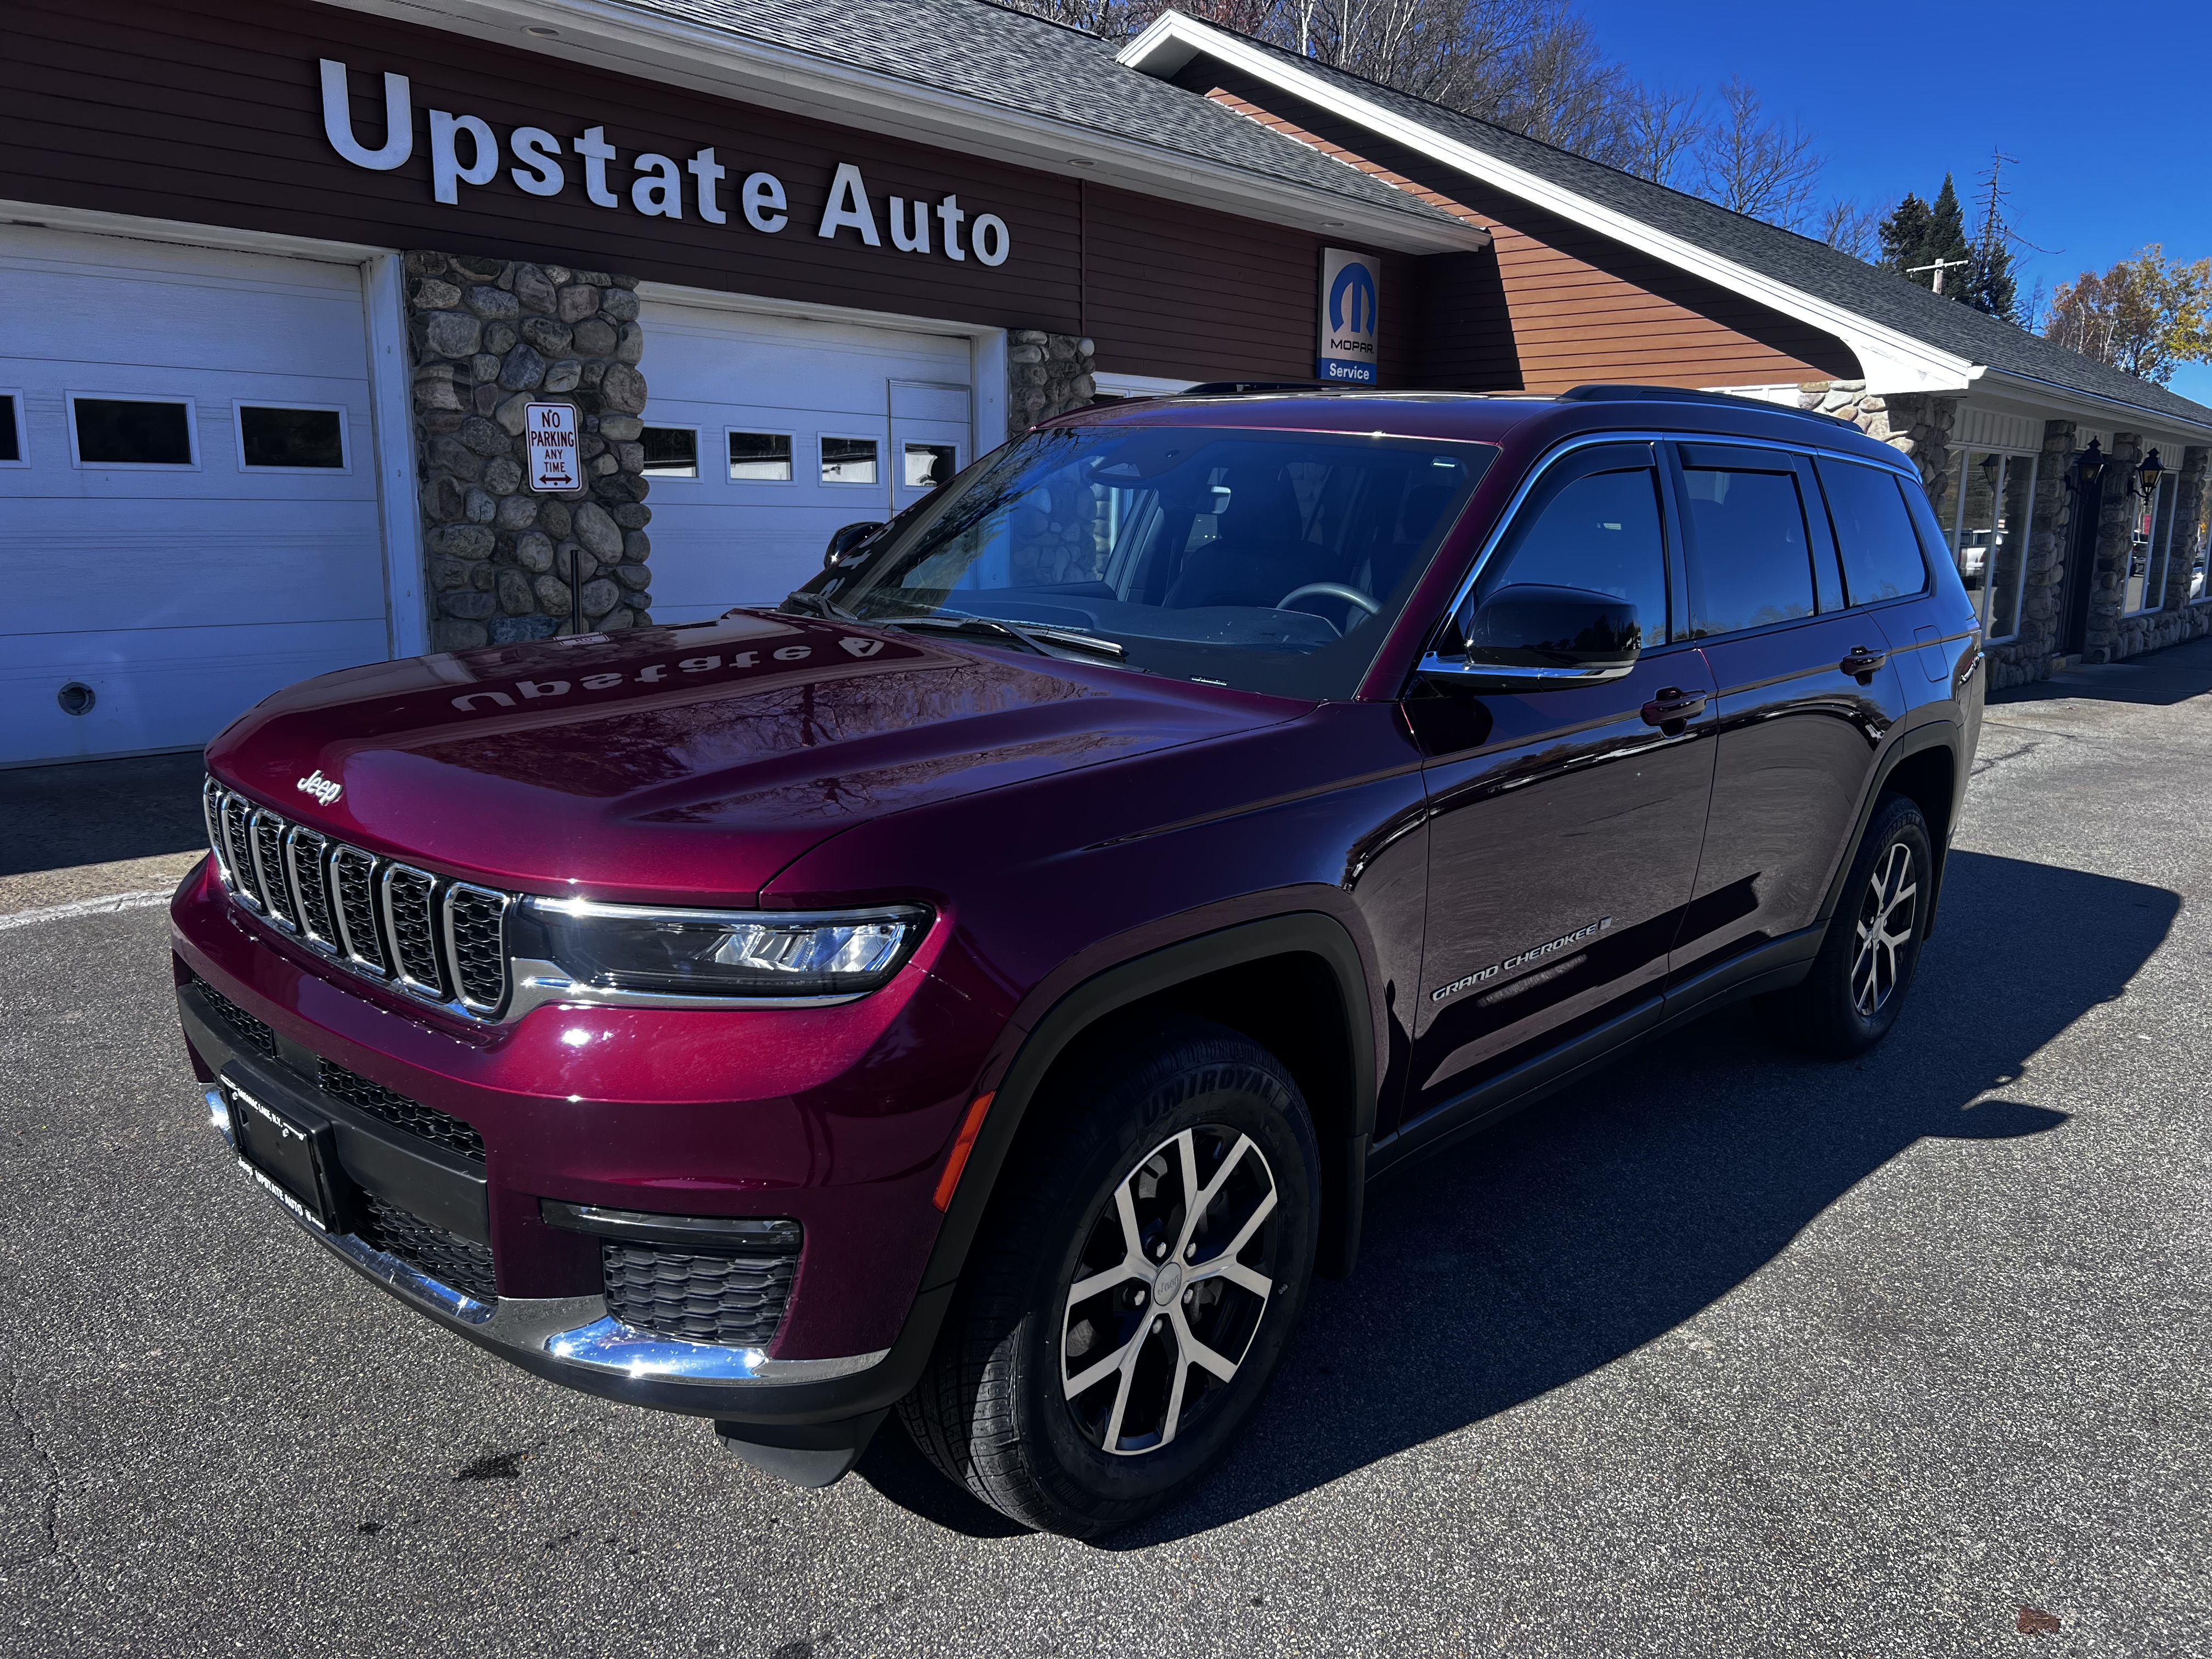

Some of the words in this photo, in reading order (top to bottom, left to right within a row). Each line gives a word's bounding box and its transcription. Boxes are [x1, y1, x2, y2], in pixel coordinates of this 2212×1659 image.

[320, 58, 789, 233] Upstate
[818, 162, 1011, 267] Auto
[1330, 338, 1373, 354] MOPAR
[1329, 363, 1370, 380] Service
[541, 412, 561, 428] NO
[531, 431, 574, 447] PARKING
[545, 449, 563, 460] ANY
[544, 462, 566, 473] TIME
[297, 769, 342, 805] Jeep
[1432, 965, 1499, 1001] GRAND
[1503, 923, 1597, 970] CHEROKEE
[1142, 1066, 1275, 1127] UNIROYAL
[255, 1170, 284, 1201] UPSTATE
[285, 1194, 303, 1216] AUTO
[1158, 1274, 1180, 1295] Jeep
